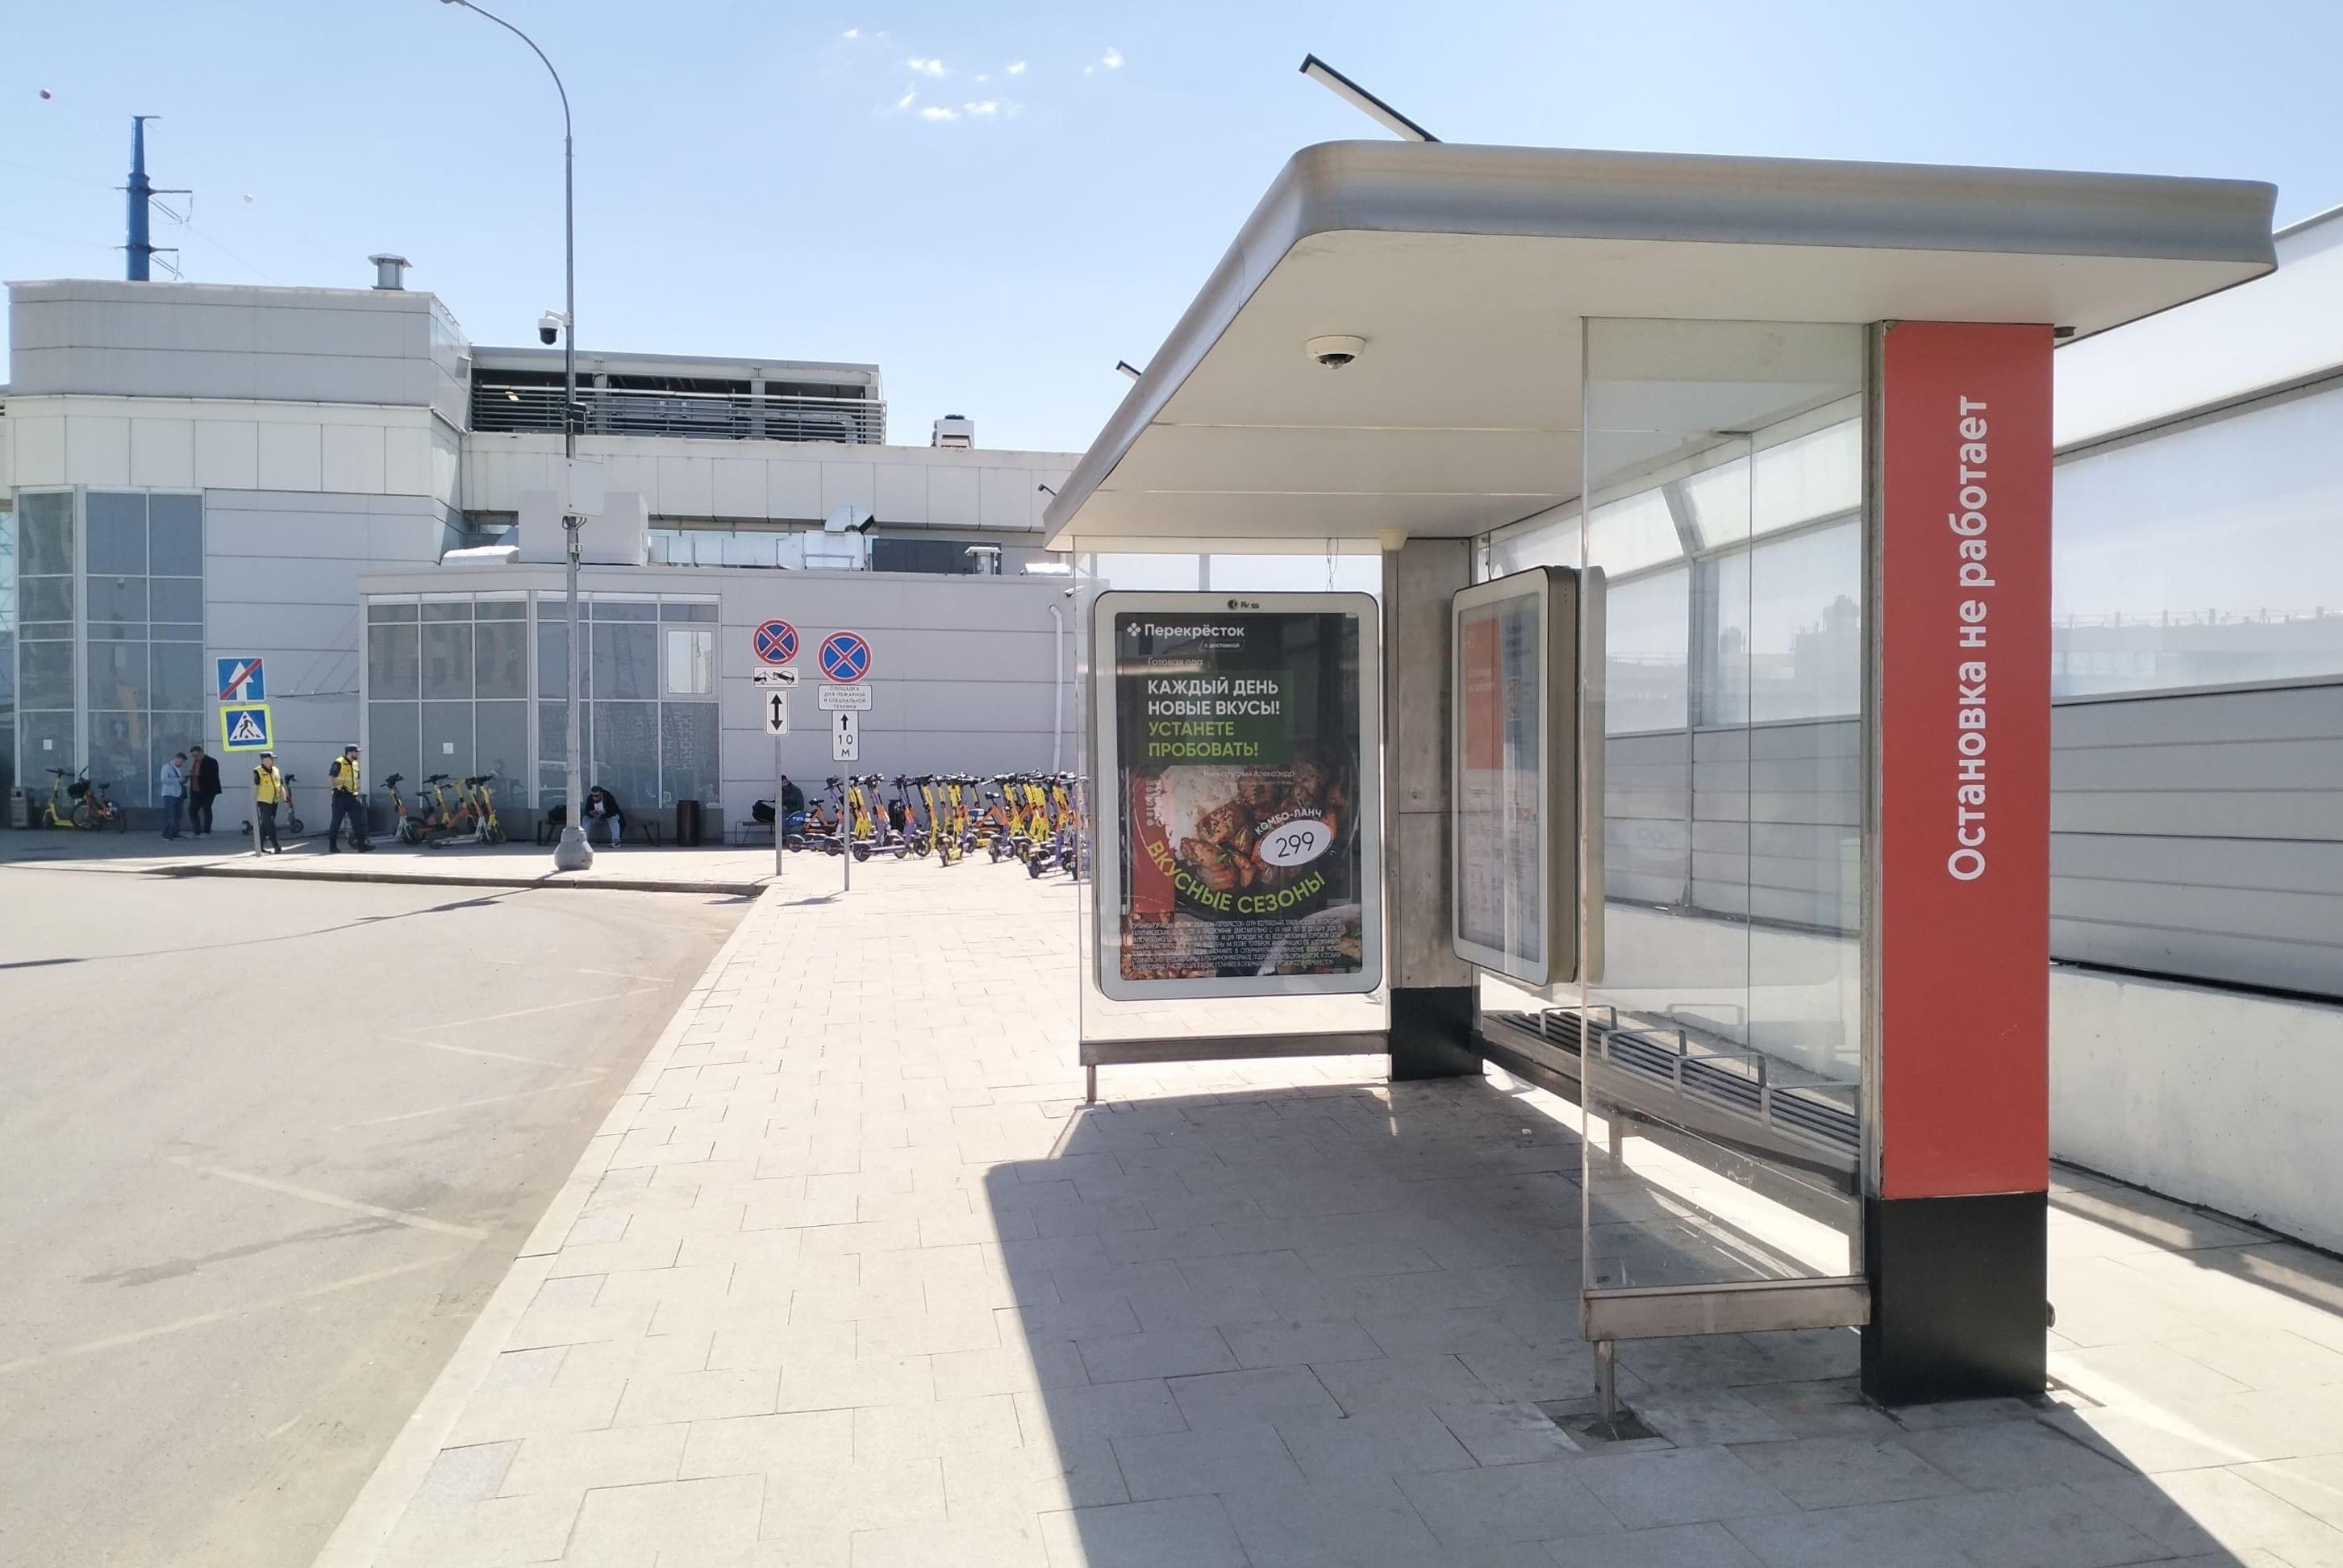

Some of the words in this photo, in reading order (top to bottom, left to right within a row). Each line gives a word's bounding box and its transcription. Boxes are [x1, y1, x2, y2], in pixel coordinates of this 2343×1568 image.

[1947, 394, 1996, 587] работает
[1144, 623, 1245, 639] Перекрёсток
[1959, 599, 1987, 648] не
[1148, 676, 1229, 697] КАЖДЫЙ
[1232, 679, 1279, 697] ДЕНЬ
[1148, 700, 1211, 715] НОВЫЕ
[1215, 700, 1281, 715] ВКУСЫ!
[1148, 720, 1235, 736] УСТАНЕТЕ
[838, 734, 853, 745] 10
[1148, 741, 1259, 757] ПРОБОВАТЬ!
[840, 749, 851, 757] М
[1947, 661, 1987, 881] Остановка
[1254, 808, 1322, 836] КОМБО-ЛАНЧ
[1275, 832, 1315, 858] 299
[1147, 839, 1233, 911] ВКУСНЫЕ
[1237, 870, 1326, 914] СЕЗОНЫ
